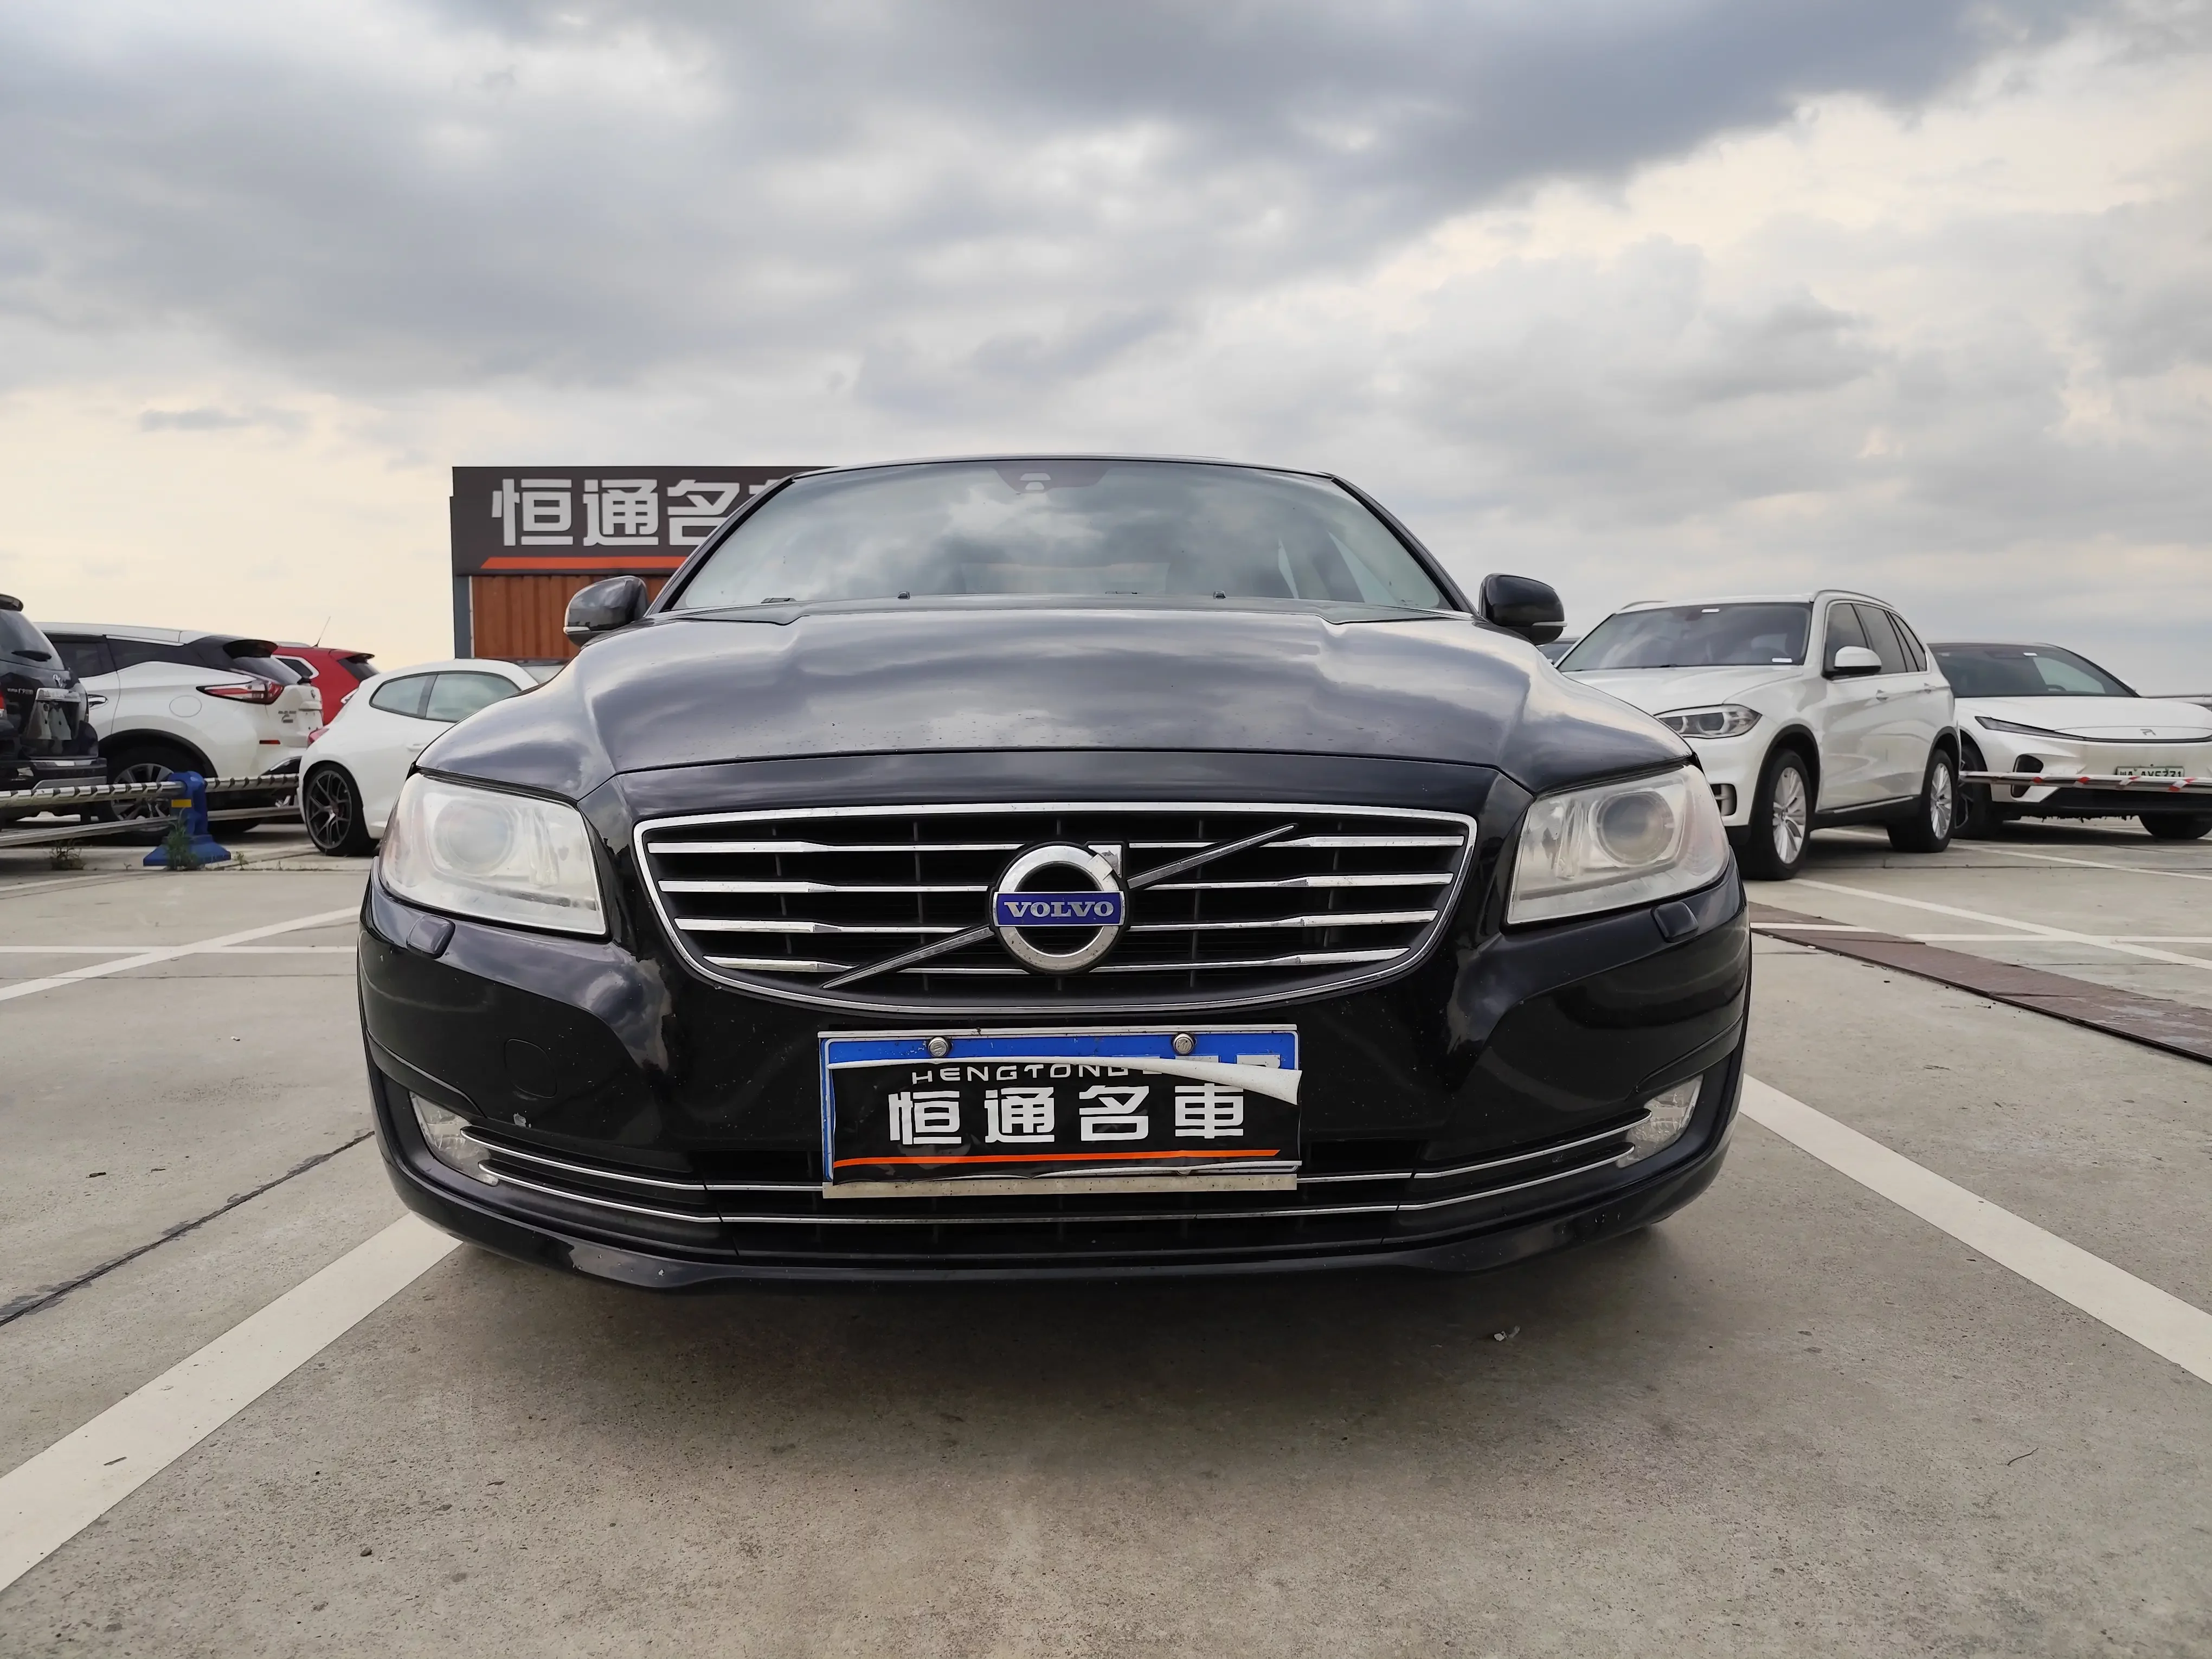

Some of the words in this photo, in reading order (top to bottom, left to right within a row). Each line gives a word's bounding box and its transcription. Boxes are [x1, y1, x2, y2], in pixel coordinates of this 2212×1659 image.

[492, 479, 780, 546] 恒通名
[1004, 901, 1114, 917] VOLVO
[888, 1083, 1244, 1145] 恒通名車
